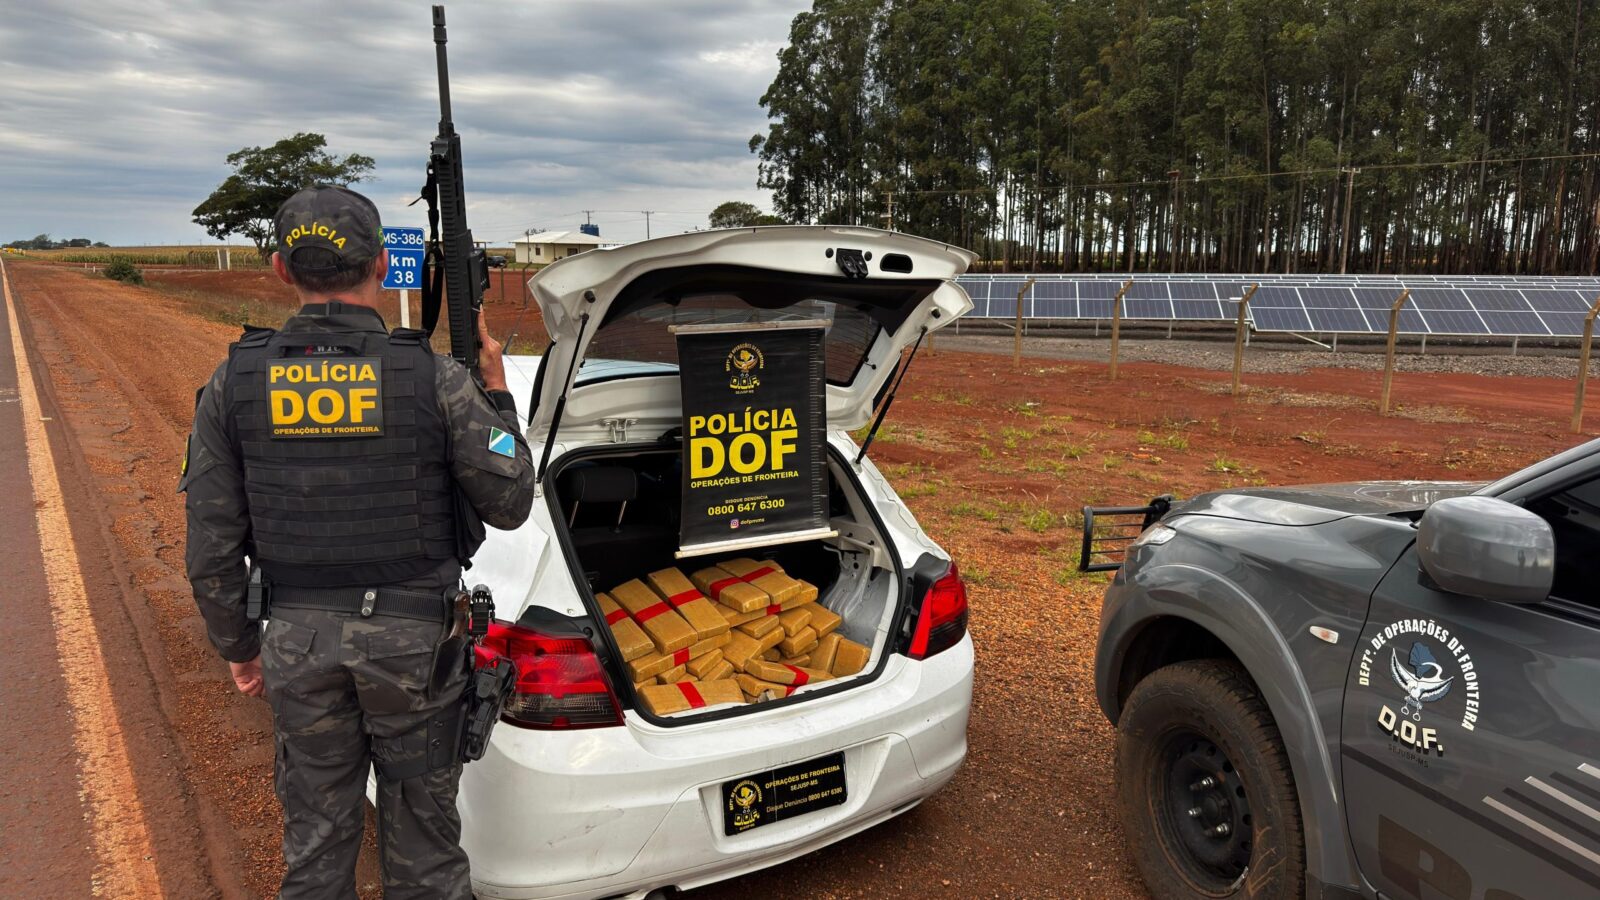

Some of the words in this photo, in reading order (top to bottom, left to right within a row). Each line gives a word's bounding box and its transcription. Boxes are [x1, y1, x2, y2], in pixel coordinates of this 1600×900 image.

[286, 221, 347, 249] POLÍCIA
[390, 254, 416, 267] km
[394, 270, 414, 284] 38
[270, 360, 377, 384] POLÍCIA
[270, 388, 378, 425] DOF
[273, 426, 320, 436] OPERAÇÕES
[334, 426, 380, 434] FRONTEIRA
[690, 406, 798, 437] POLÍCIA
[690, 429, 798, 479] DOF
[690, 477, 740, 489] OPERAÇÕES
[742, 475, 753, 483] DE
[754, 470, 799, 482] FRONTEIRA
[707, 504, 735, 516] 0800
[737, 502, 757, 513] 647
[759, 498, 785, 510] 6300
[1370, 632, 1386, 650] DE
[1384, 618, 1449, 643] OPERAÇÕES
[1446, 637, 1465, 657] DE
[1457, 653, 1480, 732] FRONTEIRA
[1377, 704, 1444, 754] D.O.F.
[800, 772, 809, 780] DE
[809, 764, 841, 777] FRONTEIRA
